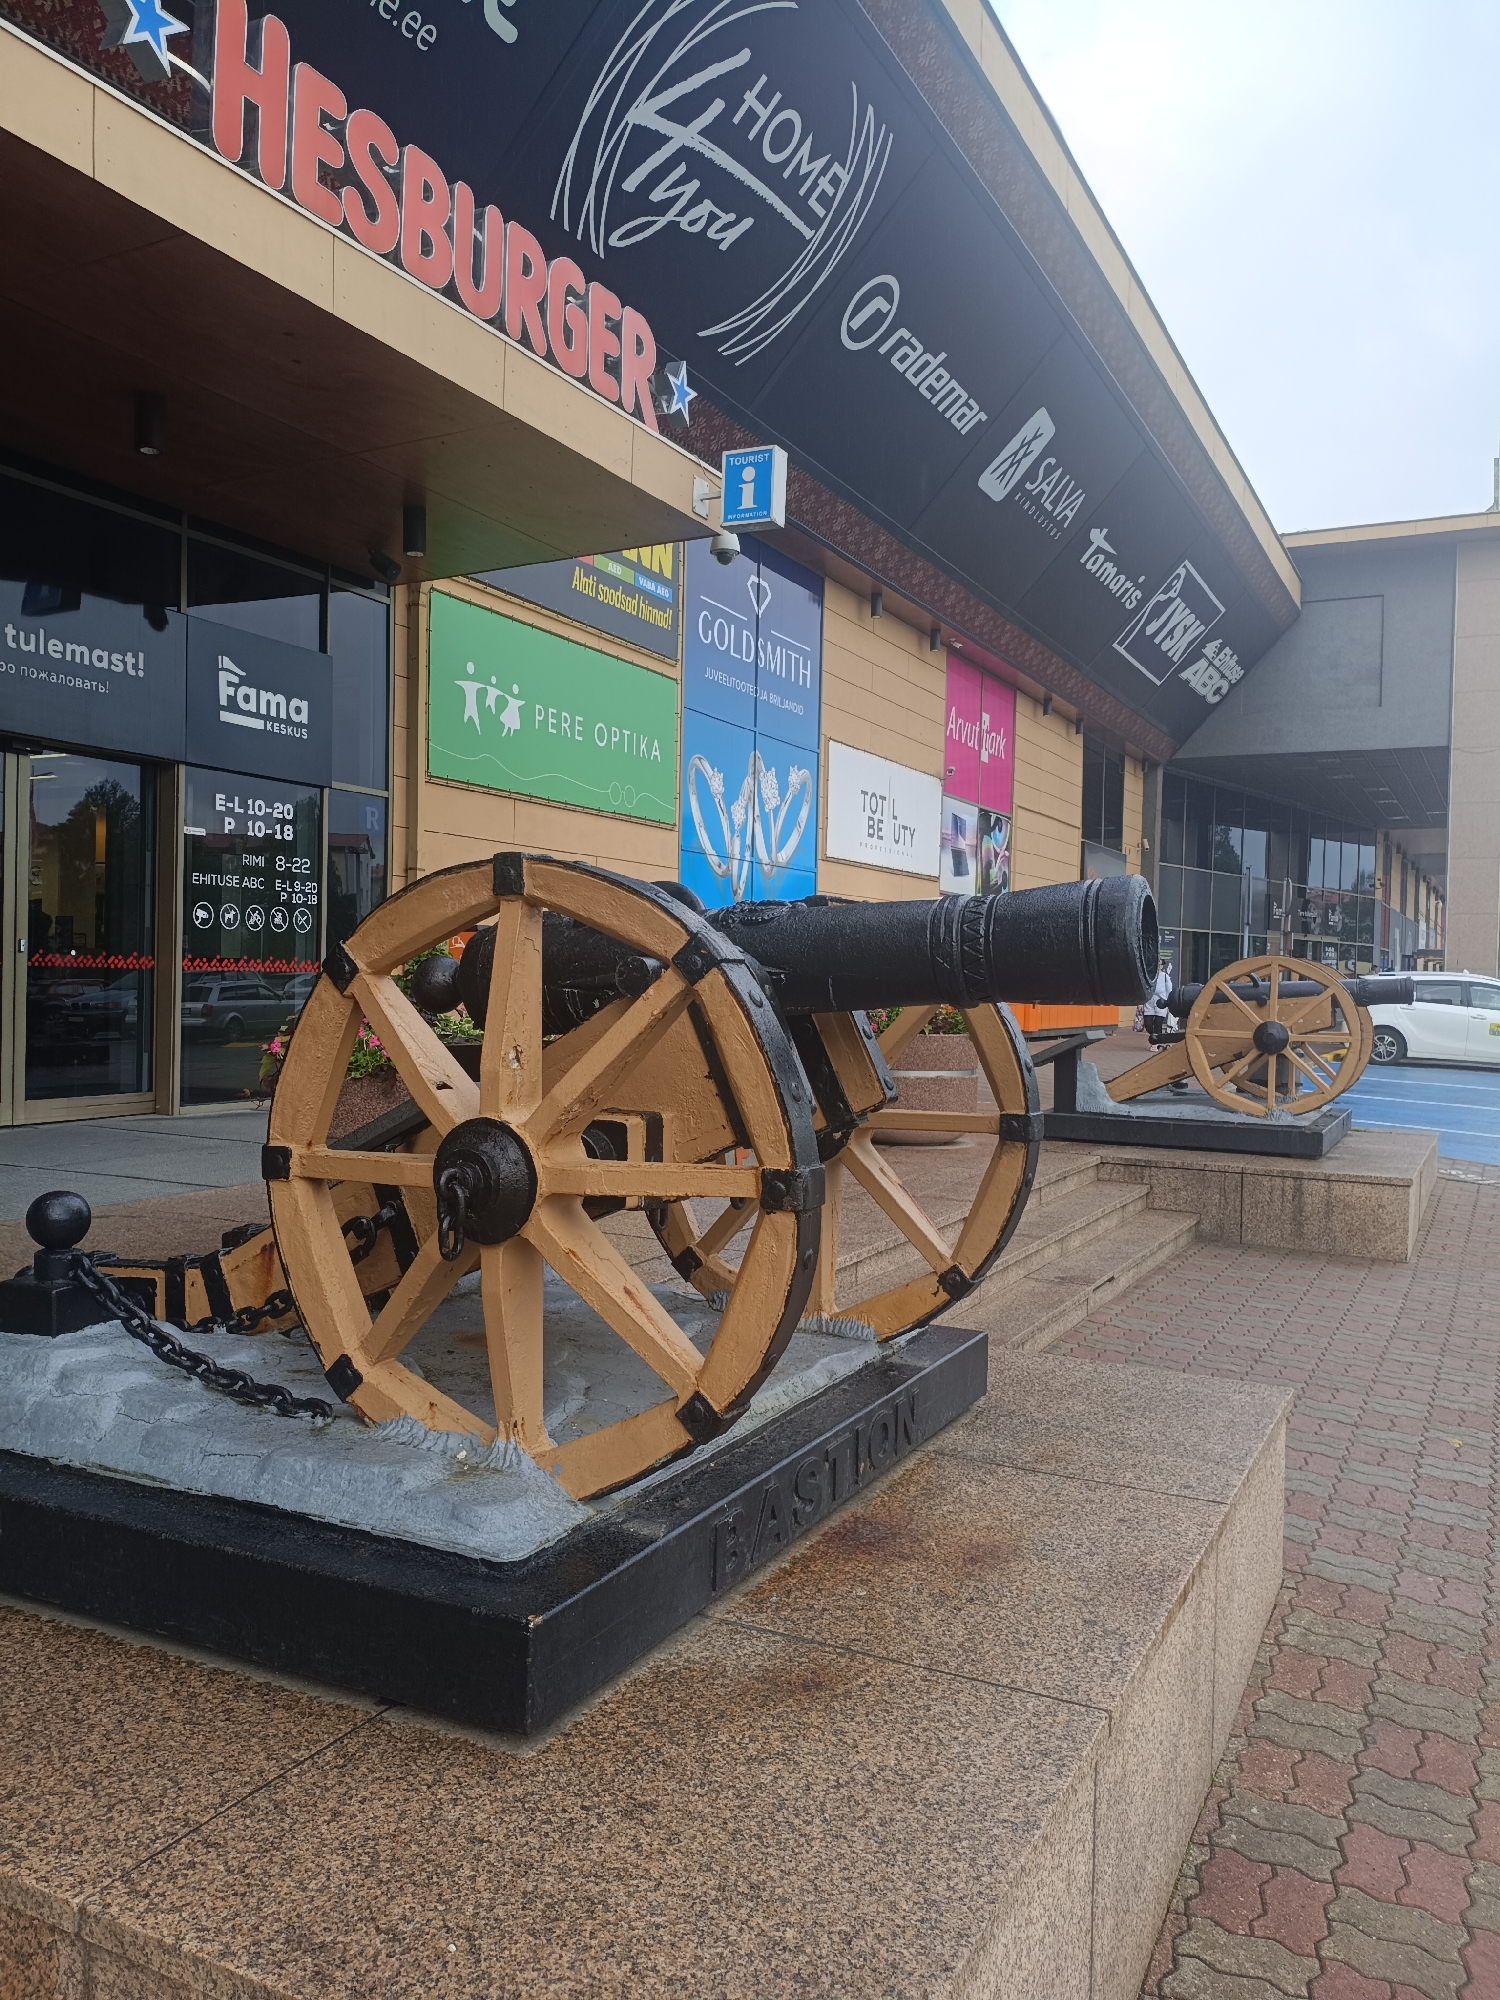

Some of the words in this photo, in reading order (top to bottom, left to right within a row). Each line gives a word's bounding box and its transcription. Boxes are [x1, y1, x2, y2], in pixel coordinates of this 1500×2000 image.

[732, 74, 850, 218] HOME
[211, 0, 658, 433] HESBURGER
[608, 162, 754, 251] you
[878, 328, 988, 436] rademar
[729, 453, 770, 466] TOURIST
[727, 510, 768, 520] INFORMATION
[1014, 492, 1061, 540] KINDLUSTUS
[1025, 457, 1085, 528] SALVA
[607, 562, 622, 575] AED
[638, 576, 656, 593] VABA
[1080, 528, 1145, 610] Tamaris
[572, 566, 597, 598] Alati
[597, 583, 638, 616] soodsad
[638, 595, 673, 631] hinnad!
[4, 623, 145, 678] tulemast!
[698, 610, 811, 689] GOLDSMITH
[1146, 597, 1206, 663] JYSK
[20, 665, 109, 694] пожаловать!
[218, 670, 309, 725] Fama
[704, 666, 760, 698] JUVEELITOOTED
[760, 690, 768, 702] JA
[769, 692, 804, 716] BRILJANDID
[1178, 656, 1230, 705] ABC
[266, 720, 308, 740] KESKUS
[535, 703, 584, 741] PERE
[594, 722, 661, 763] OPTIKA
[215, 793, 244, 814] E-L
[247, 798, 294, 820] 10-20
[224, 816, 236, 834] P
[247, 819, 294, 841] 10-18
[192, 872, 240, 888] EHITUSE
[241, 876, 265, 890] ABC
[242, 853, 265, 868] RIMI
[275, 855, 311, 874] 8-22
[275, 879, 293, 892] E-L
[293, 880, 318, 895] 9-20
[280, 891, 288, 903] P
[291, 893, 318, 905] 10-18
[709, 1388, 920, 1593] BASTION
